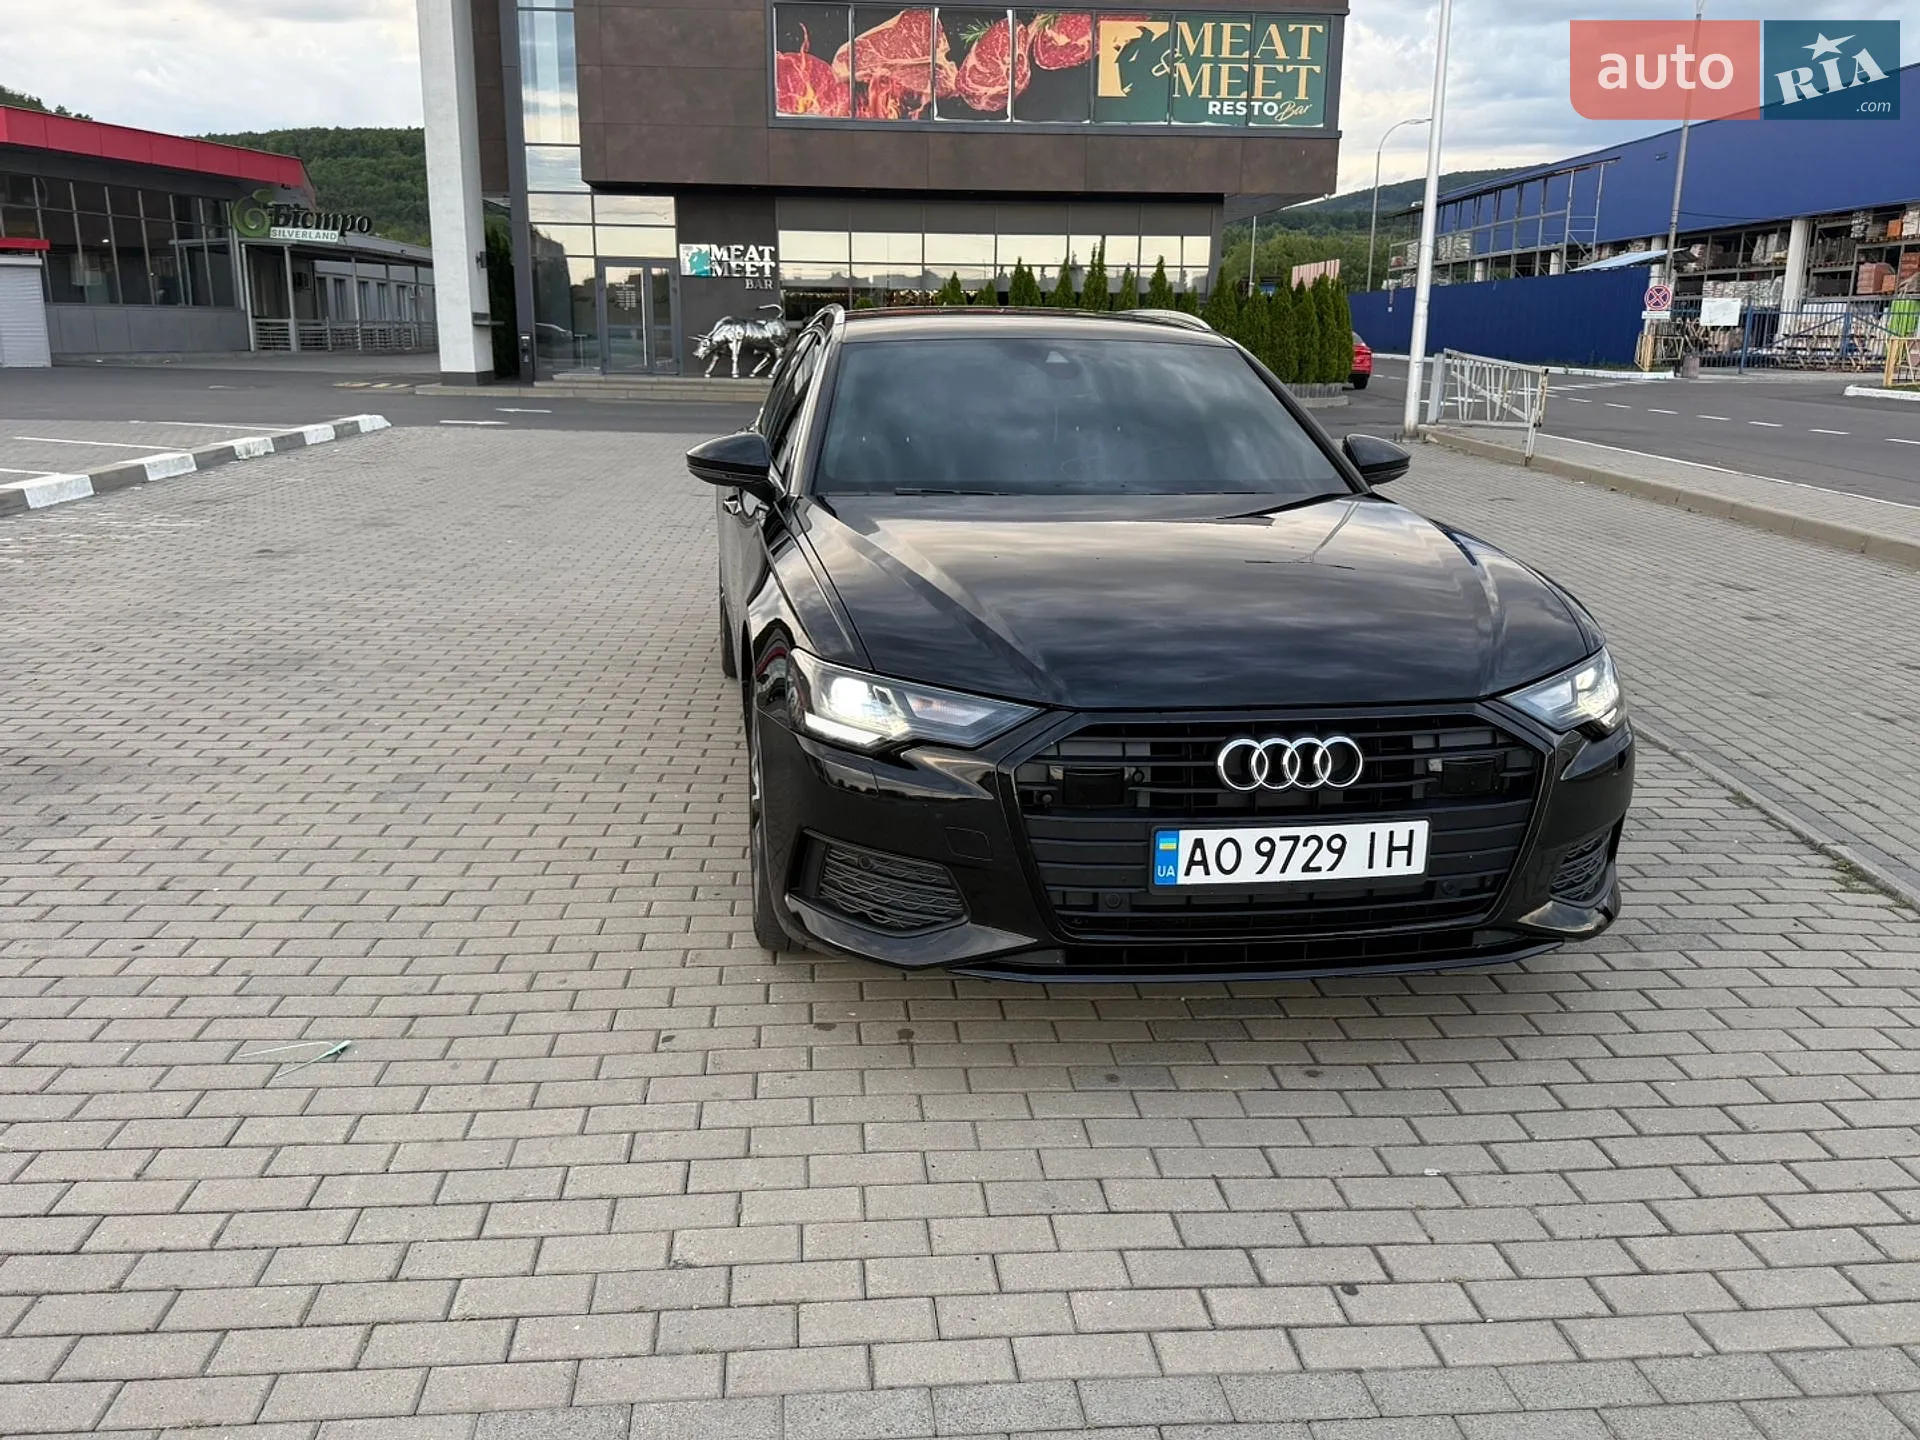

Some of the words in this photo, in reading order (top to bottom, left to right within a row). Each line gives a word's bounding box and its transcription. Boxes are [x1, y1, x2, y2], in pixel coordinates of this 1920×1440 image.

[1176, 22, 1324, 60] MEAT
[1151, 50, 1185, 77] &
[1172, 63, 1321, 99] MEET
[1207, 101, 1278, 116] RESTO
[1274, 101, 1312, 122] Bar
[271, 229, 338, 241] SILVERLAND
[710, 244, 775, 262] MEAT
[711, 261, 776, 277] MEET
[745, 279, 773, 290] BAR
[1184, 837, 1242, 877] AO
[1255, 833, 1347, 875] 9729
[1367, 829, 1415, 870] IH
[1157, 865, 1175, 878] UA
